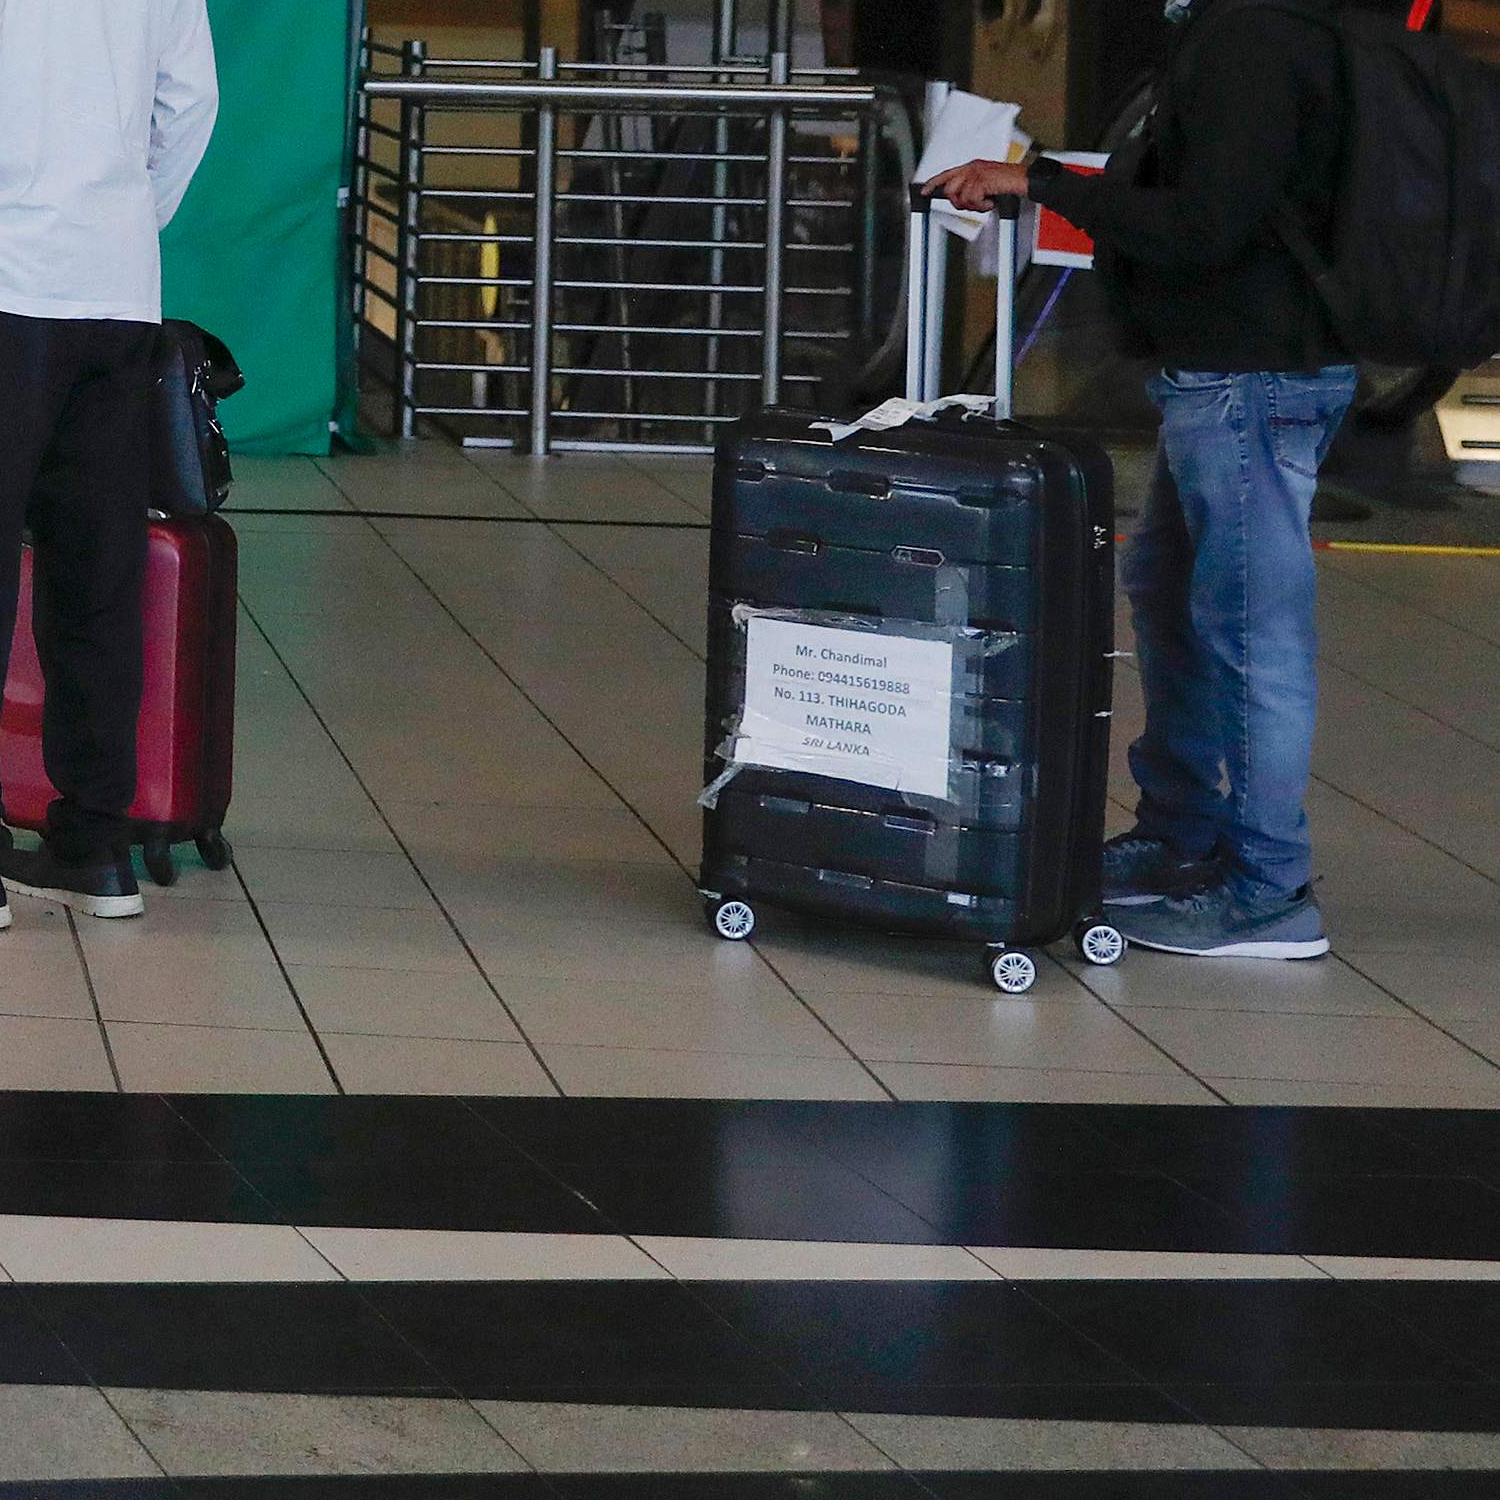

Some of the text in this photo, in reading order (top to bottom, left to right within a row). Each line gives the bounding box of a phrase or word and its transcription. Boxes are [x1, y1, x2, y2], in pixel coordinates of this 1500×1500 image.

[795, 644, 888, 668] Mr. Chandimal
[772, 663, 911, 694] Phone: 094415619888
[774, 686, 795, 700] No.
[828, 695, 908, 717] THIHAGODA
[805, 714, 873, 736] MATHARA
[801, 736, 871, 757] SRI LANKA
